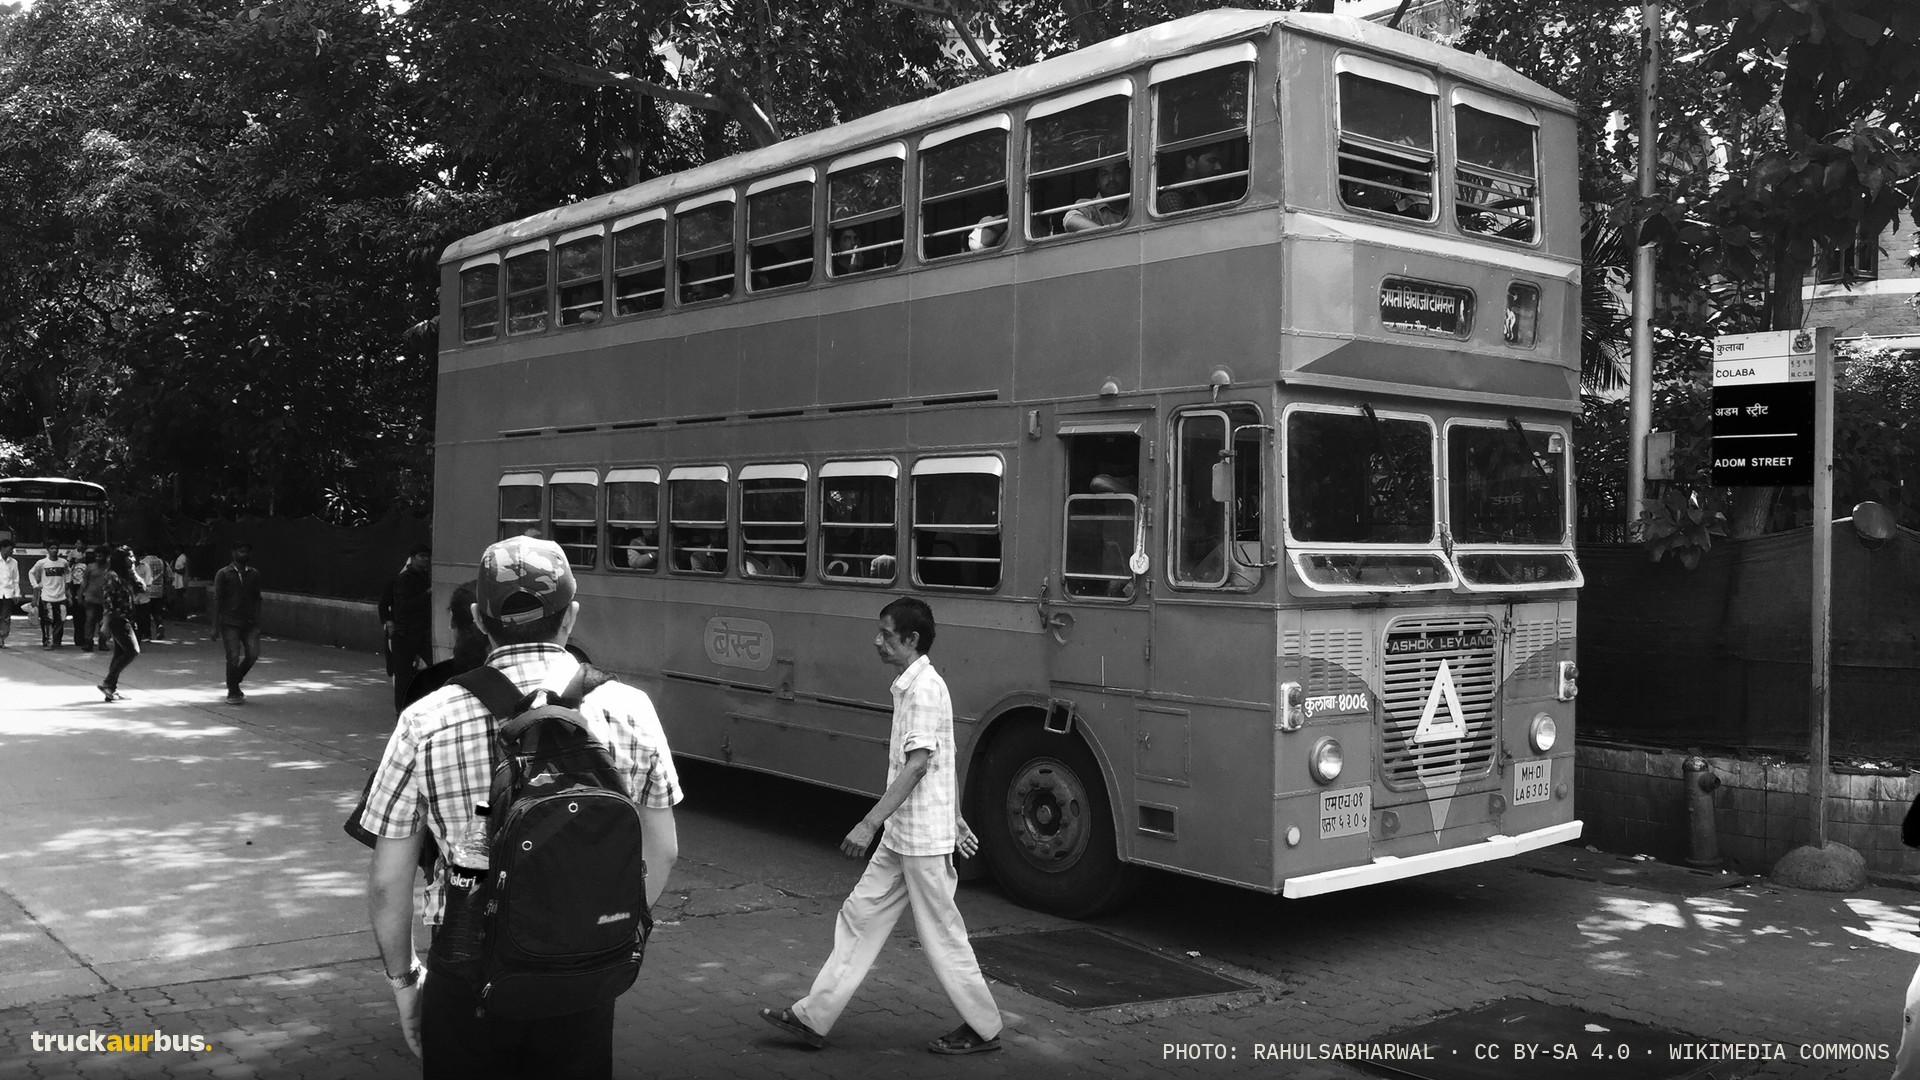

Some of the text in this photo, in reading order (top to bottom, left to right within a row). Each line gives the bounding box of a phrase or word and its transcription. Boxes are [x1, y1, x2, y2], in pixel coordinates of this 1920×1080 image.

[1716, 343, 1745, 356] कुलाबा
[1715, 368, 1756, 379] COLABA
[1714, 403, 1769, 418] अडम स्ट्रीट
[1714, 457, 1794, 468] ADOM STREET
[713, 621, 763, 661] बेस्ट
[1390, 635, 1495, 652] ASHOK LEYLAND
[1515, 783, 1549, 801] LA6305
